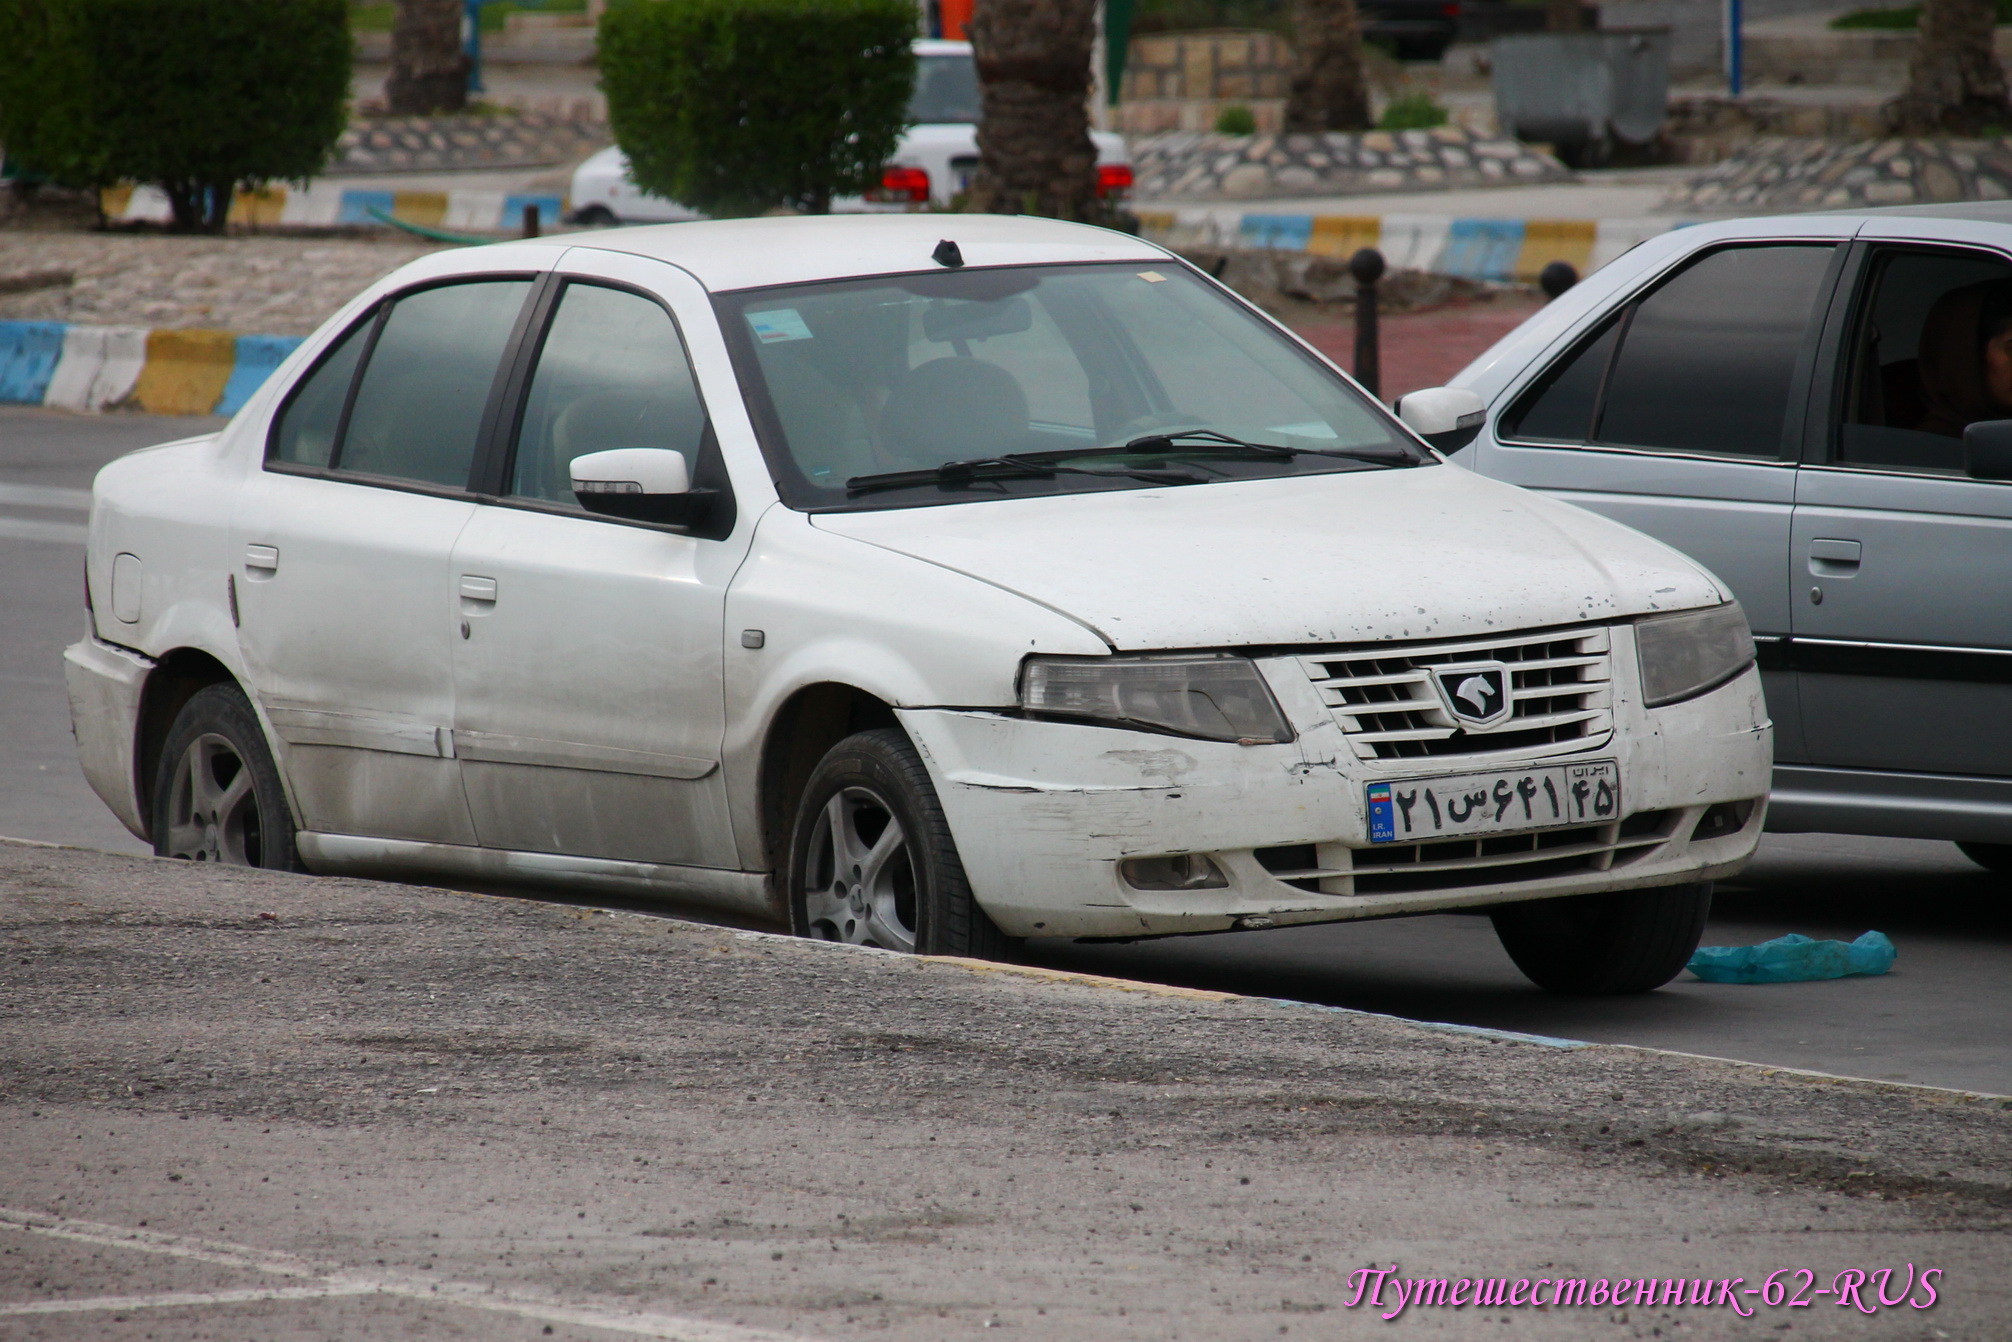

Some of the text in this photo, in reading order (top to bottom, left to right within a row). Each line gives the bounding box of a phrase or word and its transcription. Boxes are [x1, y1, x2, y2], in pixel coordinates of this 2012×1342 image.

[1573, 766, 1609, 778] ایران
[1571, 779, 1614, 818] ۴۵
[1373, 830, 1393, 839] IRAN
